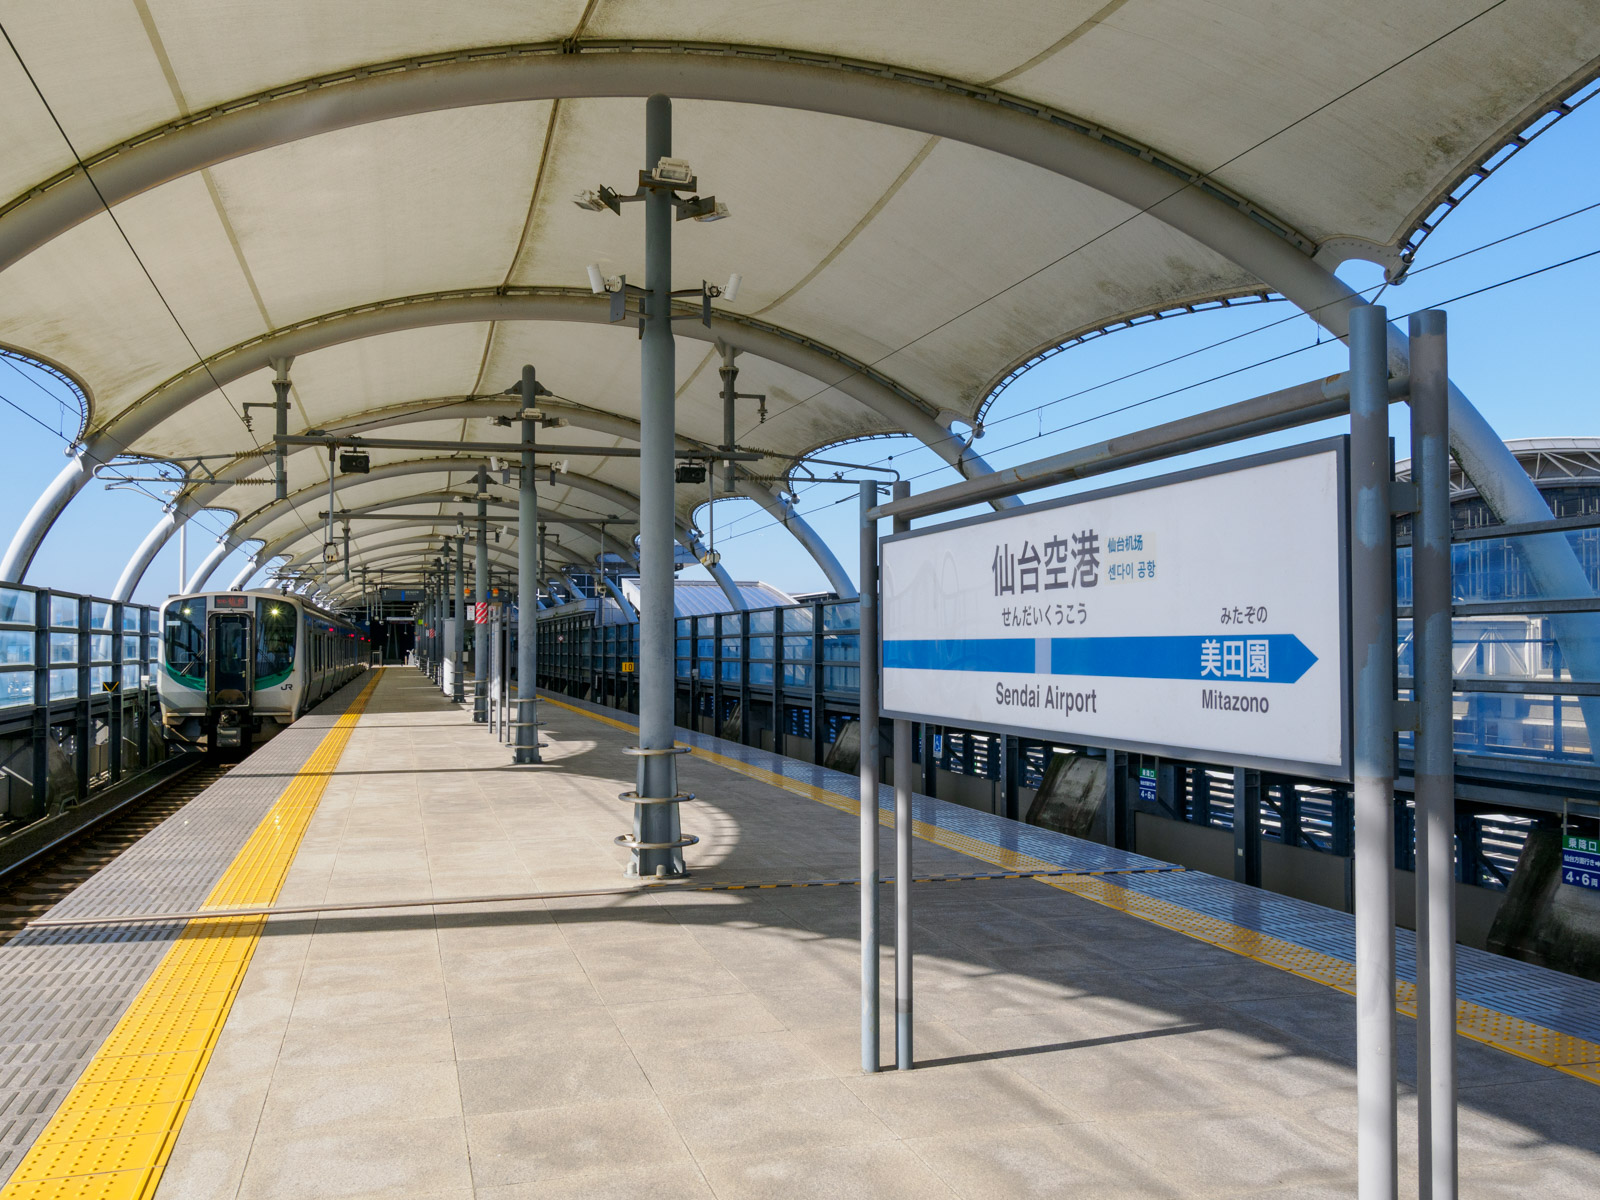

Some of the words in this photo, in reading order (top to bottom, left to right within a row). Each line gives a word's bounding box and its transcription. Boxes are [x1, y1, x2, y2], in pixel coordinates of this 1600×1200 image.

[1107, 534, 1144, 553] 仙台机场
[992, 528, 1100, 596] 仙台空港
[1108, 562, 1134, 580] 센다이
[1137, 560, 1156, 578] 공항
[1001, 603, 1088, 627] せんだいくうこう
[1219, 606, 1268, 625] みたぞの
[1200, 638, 1270, 679] 美田園
[995, 681, 1041, 708] Sendai
[1044, 684, 1098, 717] Airport
[1201, 688, 1270, 714] Mitazono
[1568, 838, 1596, 852] 乗降口
